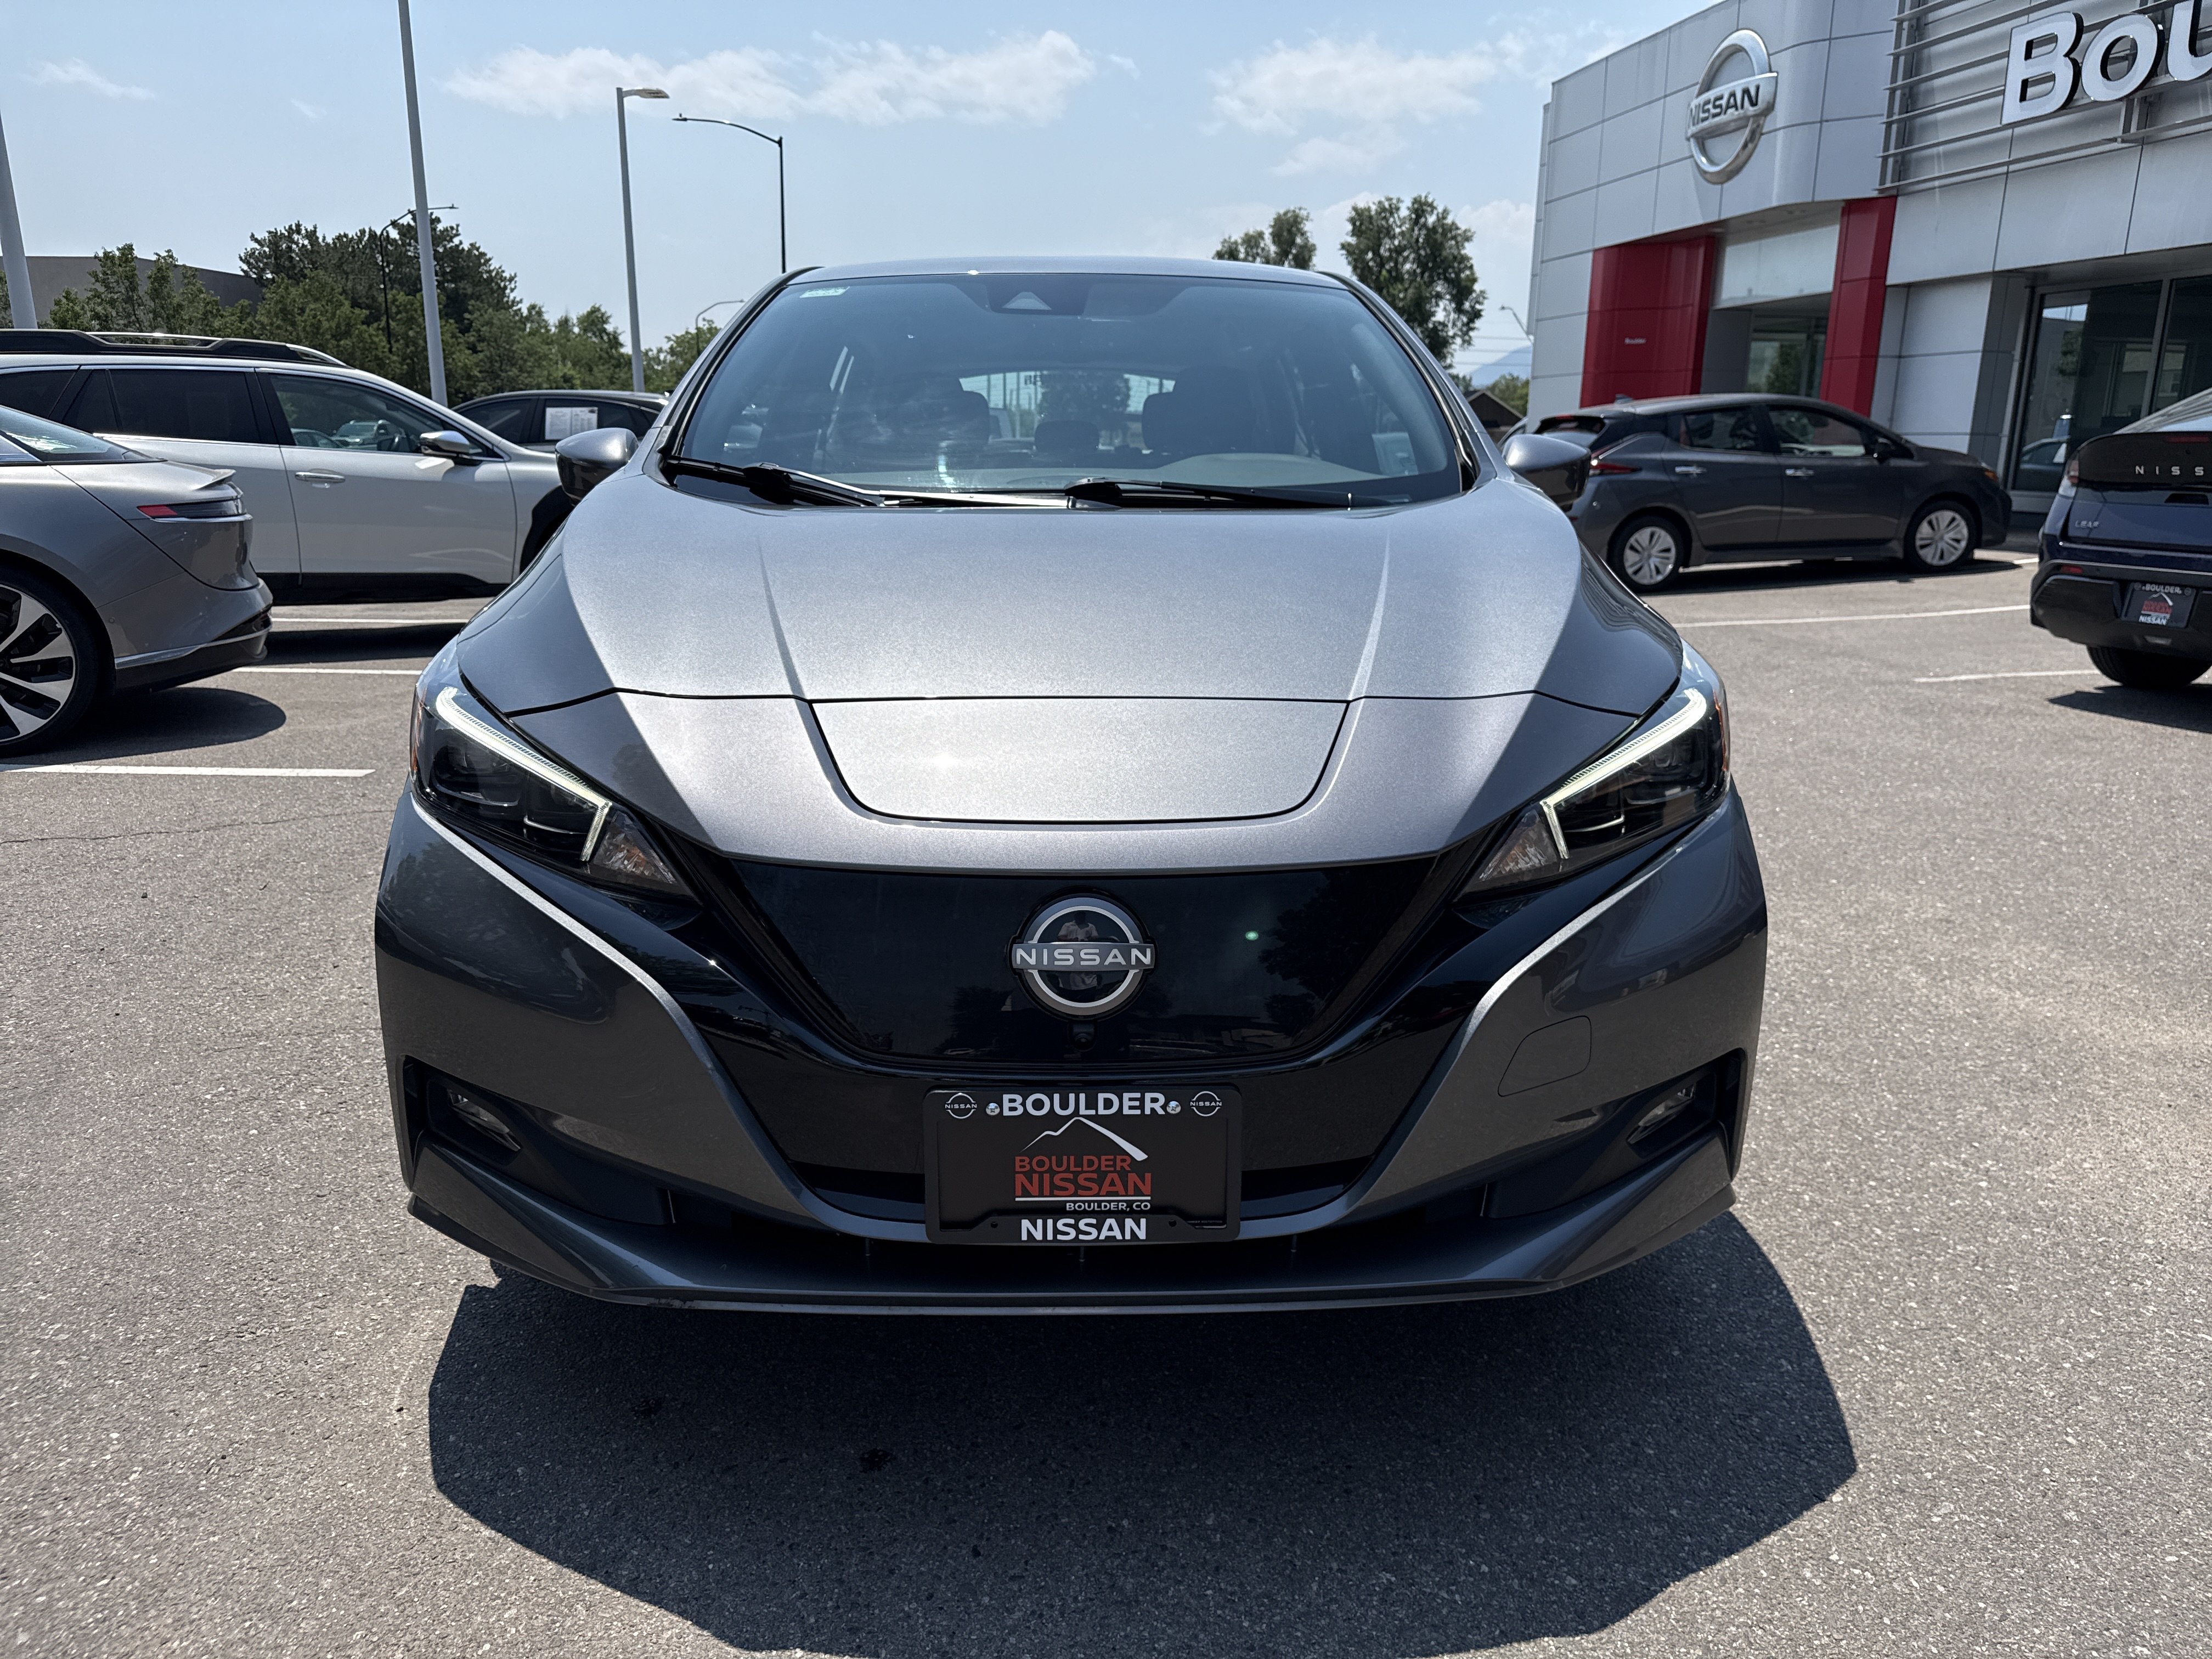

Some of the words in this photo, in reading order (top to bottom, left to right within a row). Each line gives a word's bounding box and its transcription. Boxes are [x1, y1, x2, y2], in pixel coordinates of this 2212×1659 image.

[1690, 83, 1760, 126] NISSAN
[1016, 948, 1151, 966] NISSAN
[1002, 1092, 1166, 1116] BOULDER
[1015, 1155, 1131, 1172] BOULDER
[1015, 1172, 1151, 1197] NISSAN
[1066, 1202, 1130, 1211] BOULDER,
[1132, 1202, 1151, 1210] CO
[1021, 1218, 1147, 1241] NISSAN
